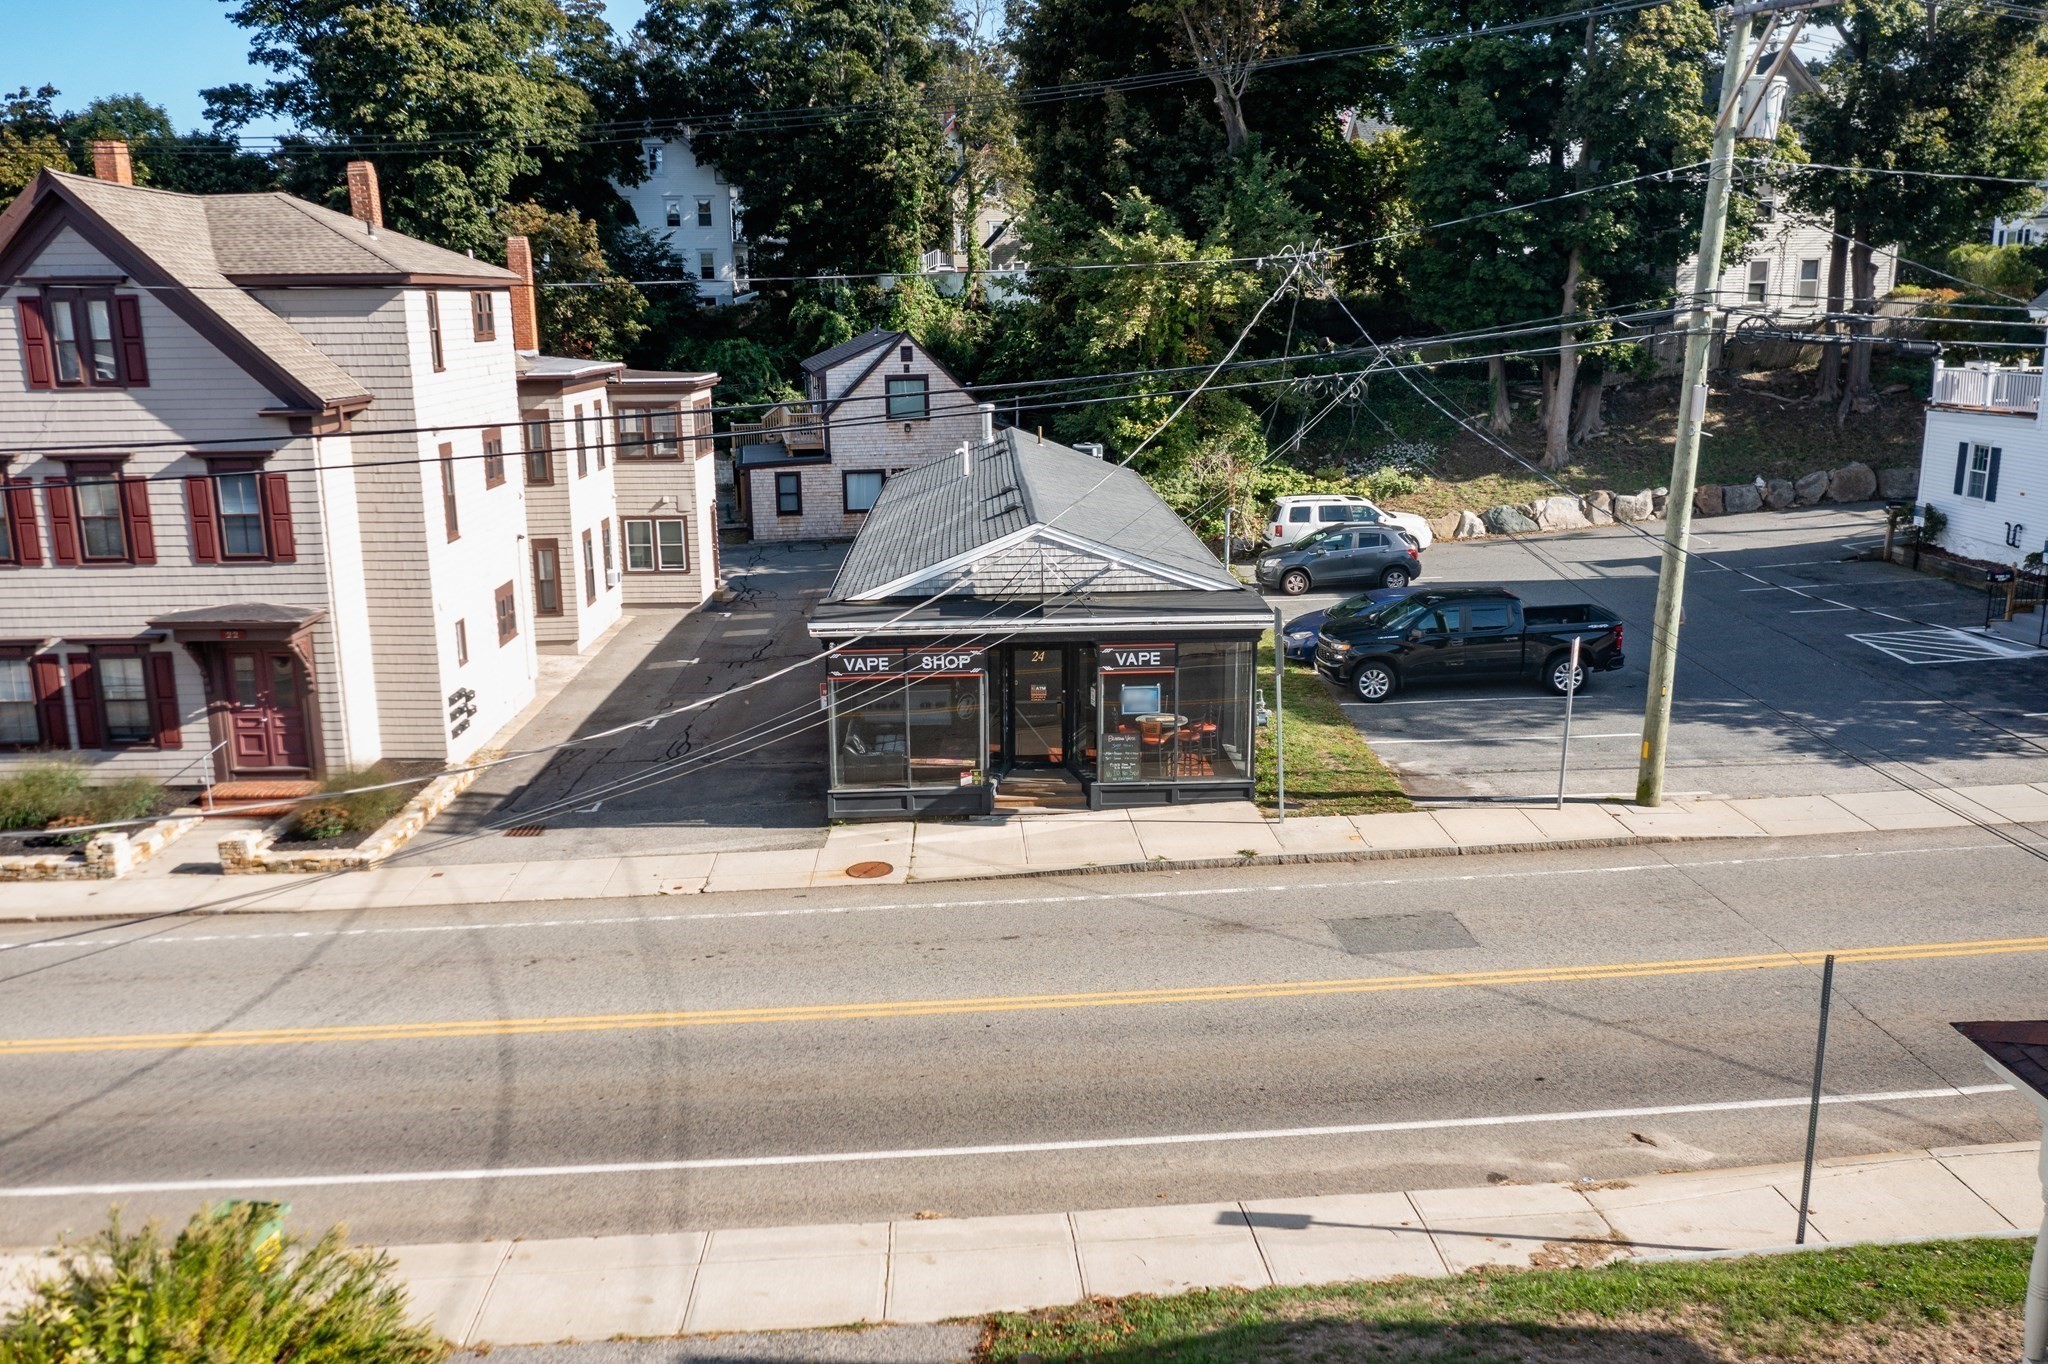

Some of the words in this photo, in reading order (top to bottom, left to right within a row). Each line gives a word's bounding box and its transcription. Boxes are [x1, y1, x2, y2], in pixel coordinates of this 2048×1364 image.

[844, 657, 889, 671] VAPE
[921, 655, 971, 669] SHOP
[1031, 651, 1045, 662] 24
[1115, 652, 1160, 666] VAPE
